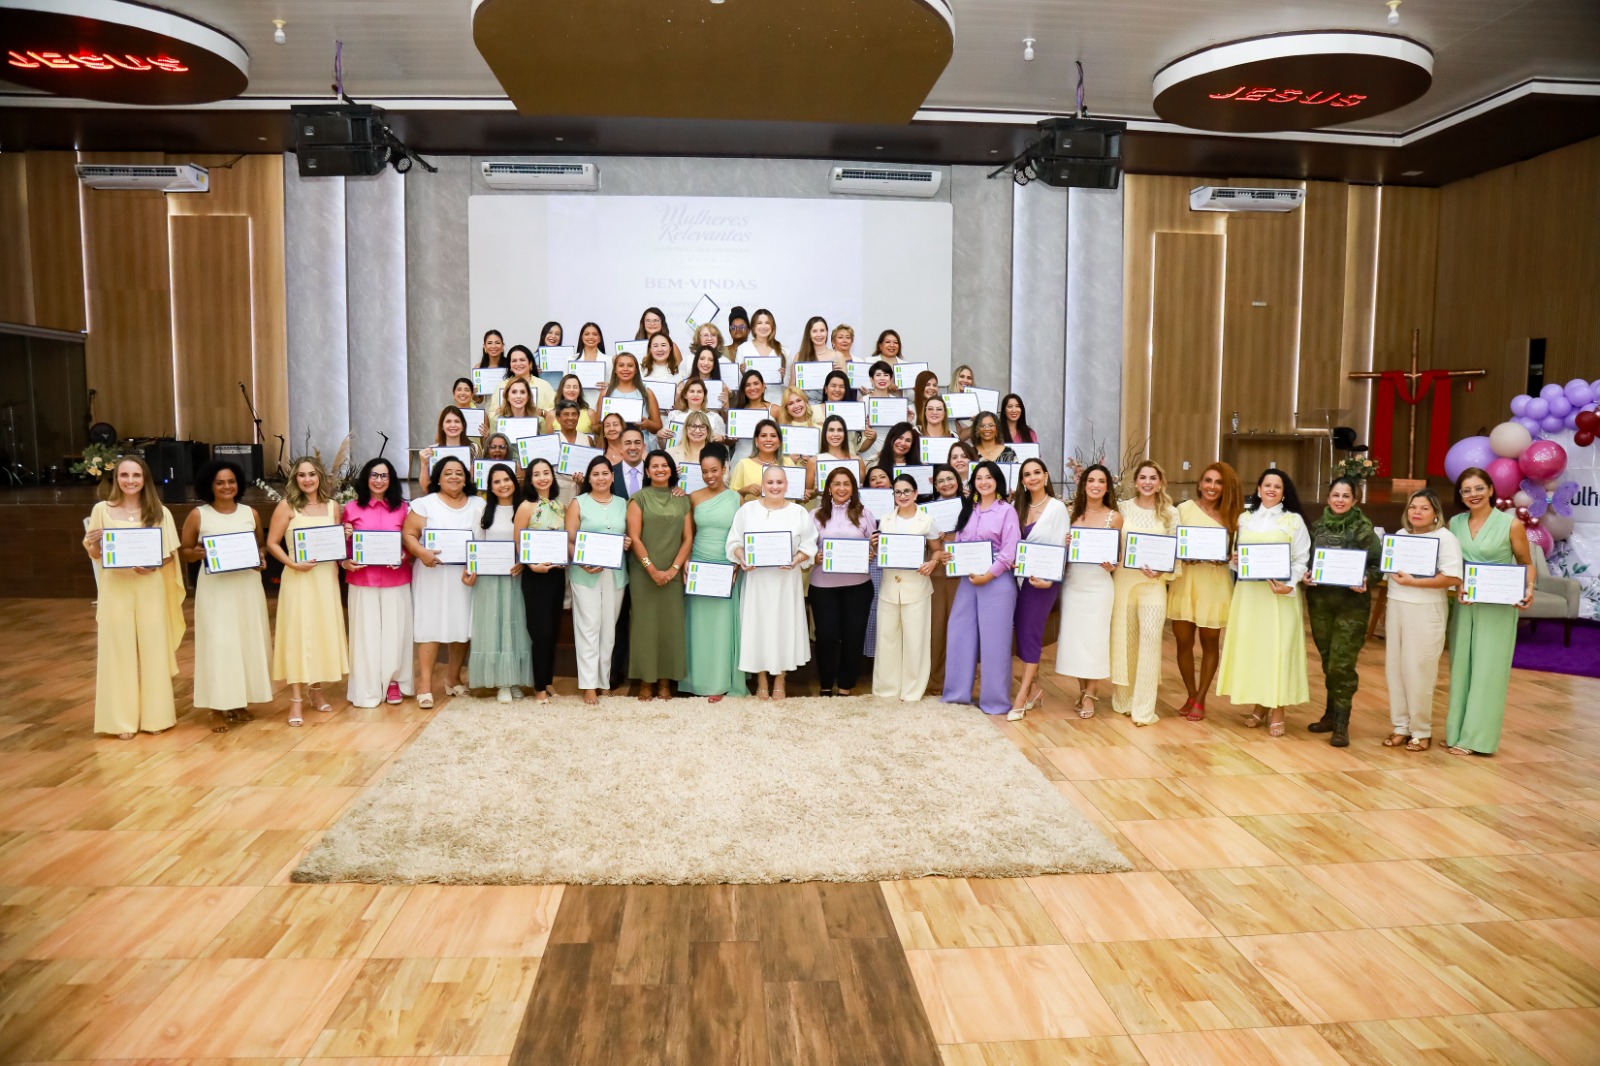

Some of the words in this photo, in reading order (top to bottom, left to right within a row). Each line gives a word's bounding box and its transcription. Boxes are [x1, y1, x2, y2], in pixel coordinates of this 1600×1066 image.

[1208, 86, 1368, 108] JESUS
[656, 203, 751, 227] Mulheres
[658, 223, 752, 244] Relevantes
[644, 277, 758, 290] BEM-VINDAS
[1567, 486, 1600, 507] ulh
